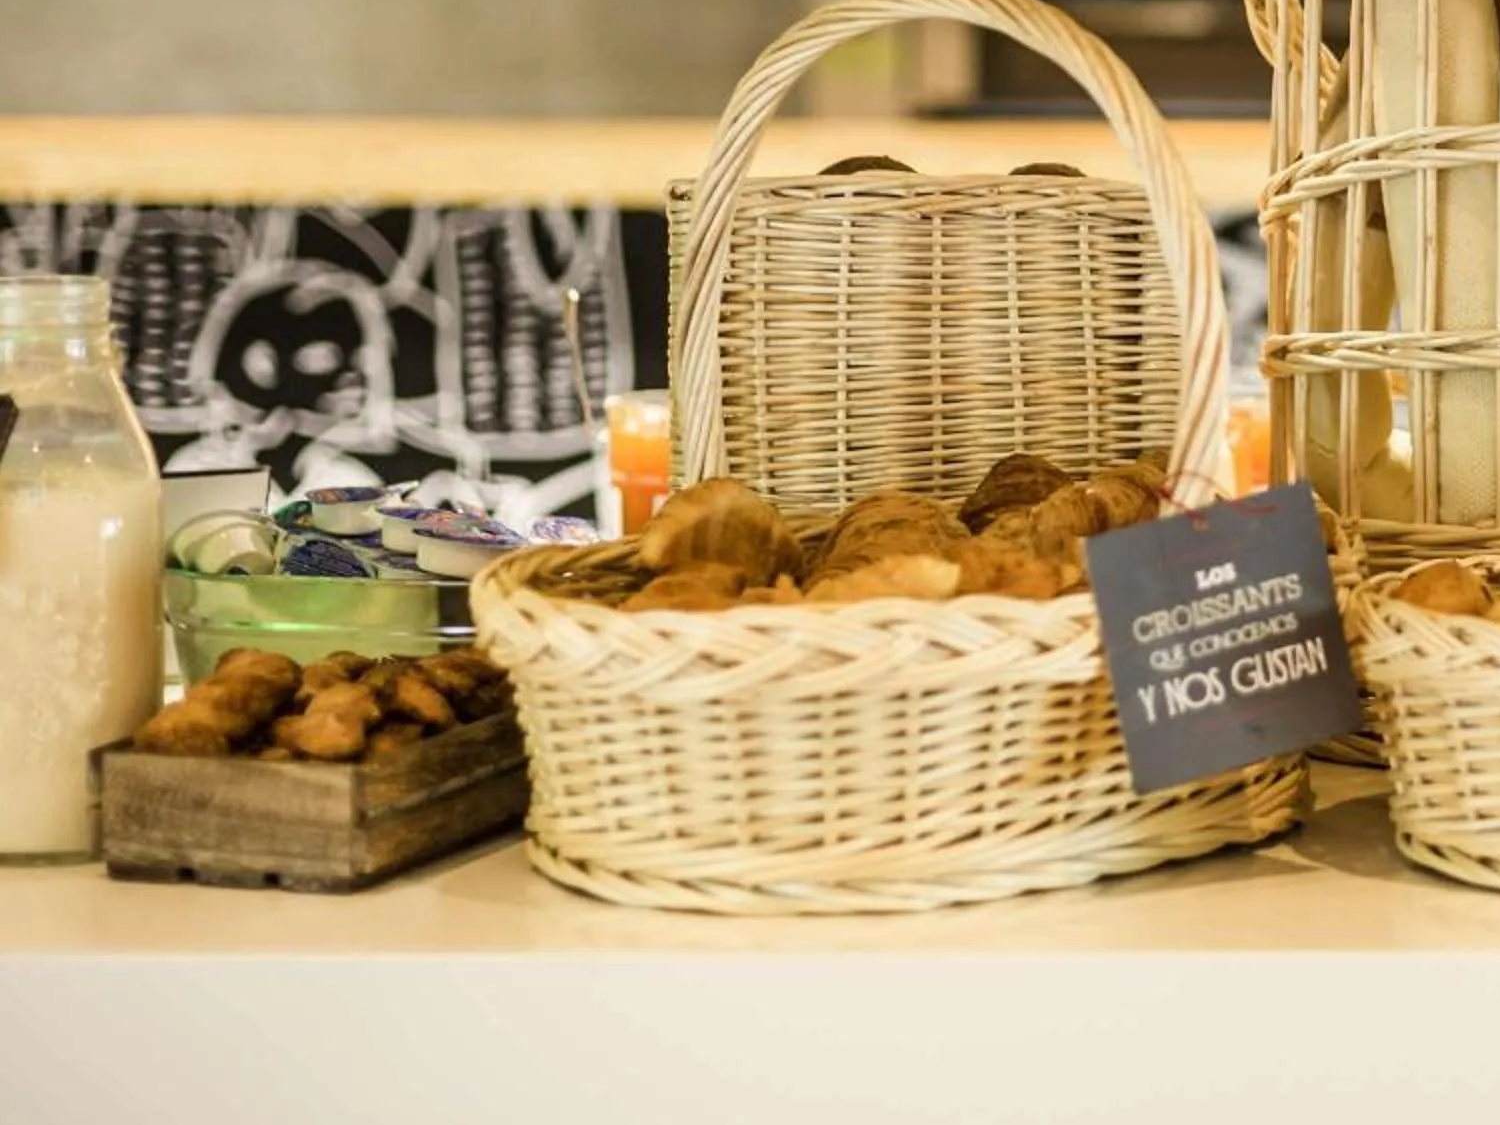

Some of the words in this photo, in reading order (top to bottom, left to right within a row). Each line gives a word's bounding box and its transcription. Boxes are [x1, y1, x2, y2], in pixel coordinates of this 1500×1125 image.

[1132, 574, 1302, 644] CROISSANTS
[1189, 612, 1298, 659] CONOCEMOS
[1137, 686, 1156, 723] Y
[1163, 667, 1225, 716] NOS
[1230, 637, 1327, 695] GUSTAN
